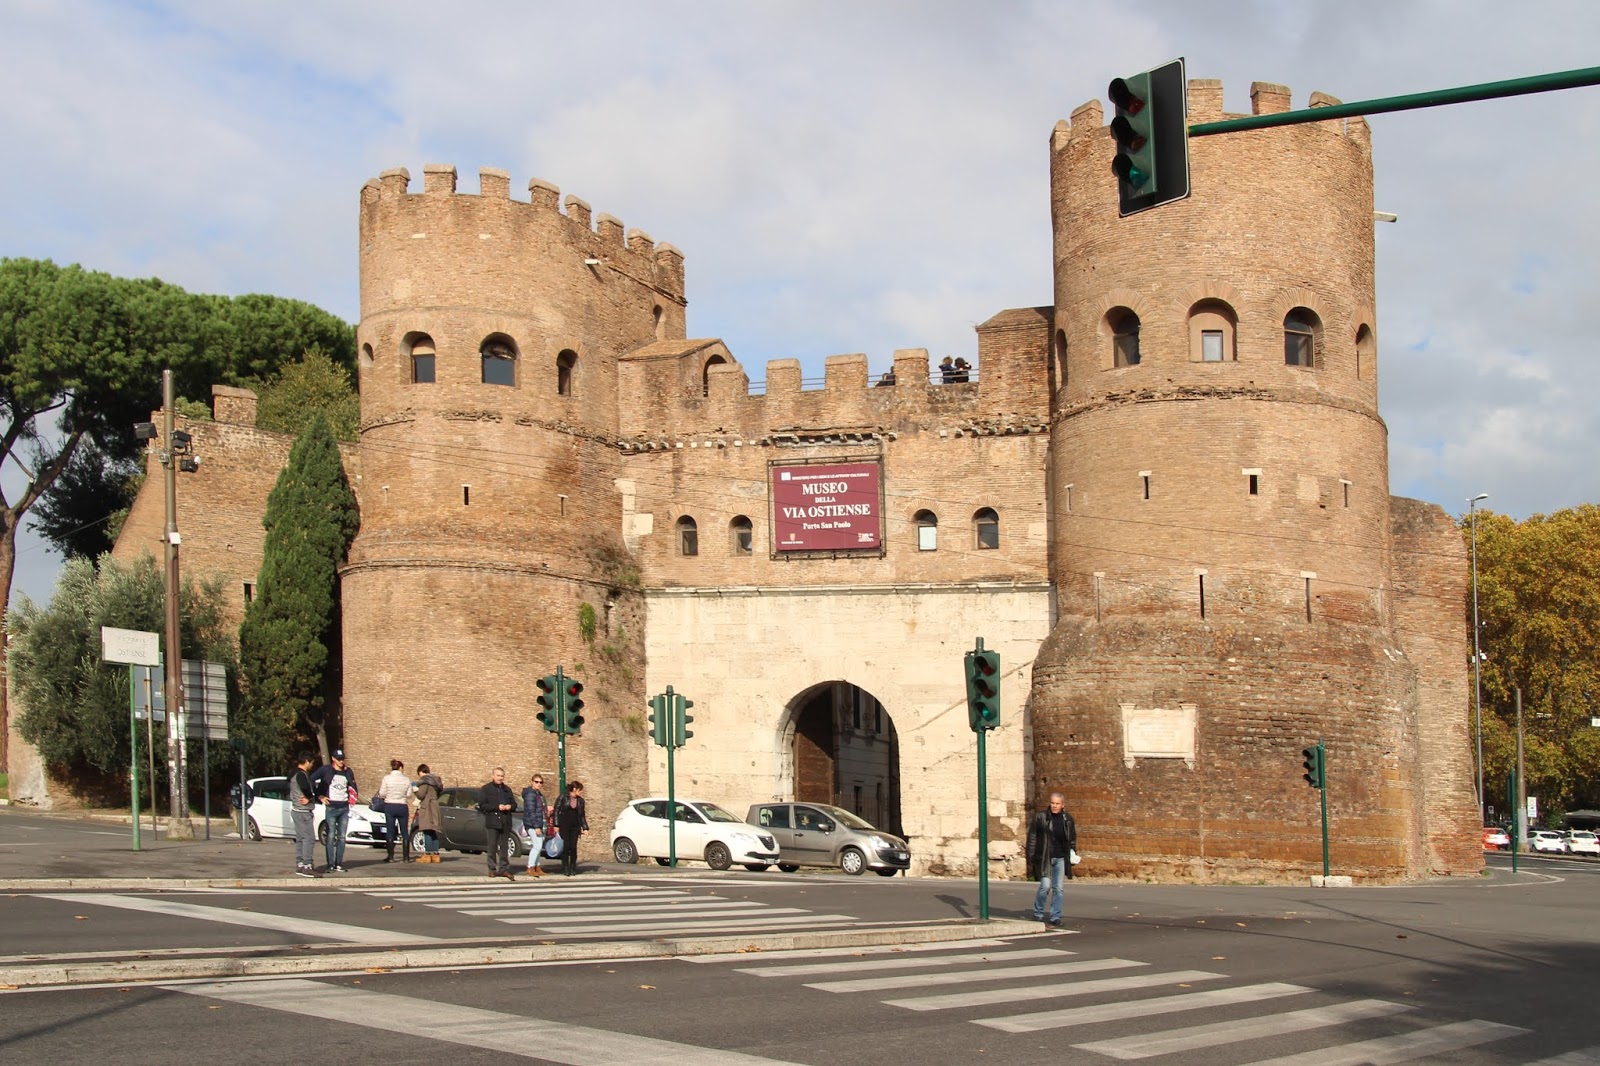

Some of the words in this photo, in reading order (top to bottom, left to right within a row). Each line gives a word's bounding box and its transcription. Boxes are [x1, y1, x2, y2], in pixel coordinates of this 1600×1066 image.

[802, 482, 848, 495] MUSEO
[783, 507, 806, 518] VIA
[808, 504, 870, 517] OSTIENSE
[117, 648, 146, 658] OSTENSE
